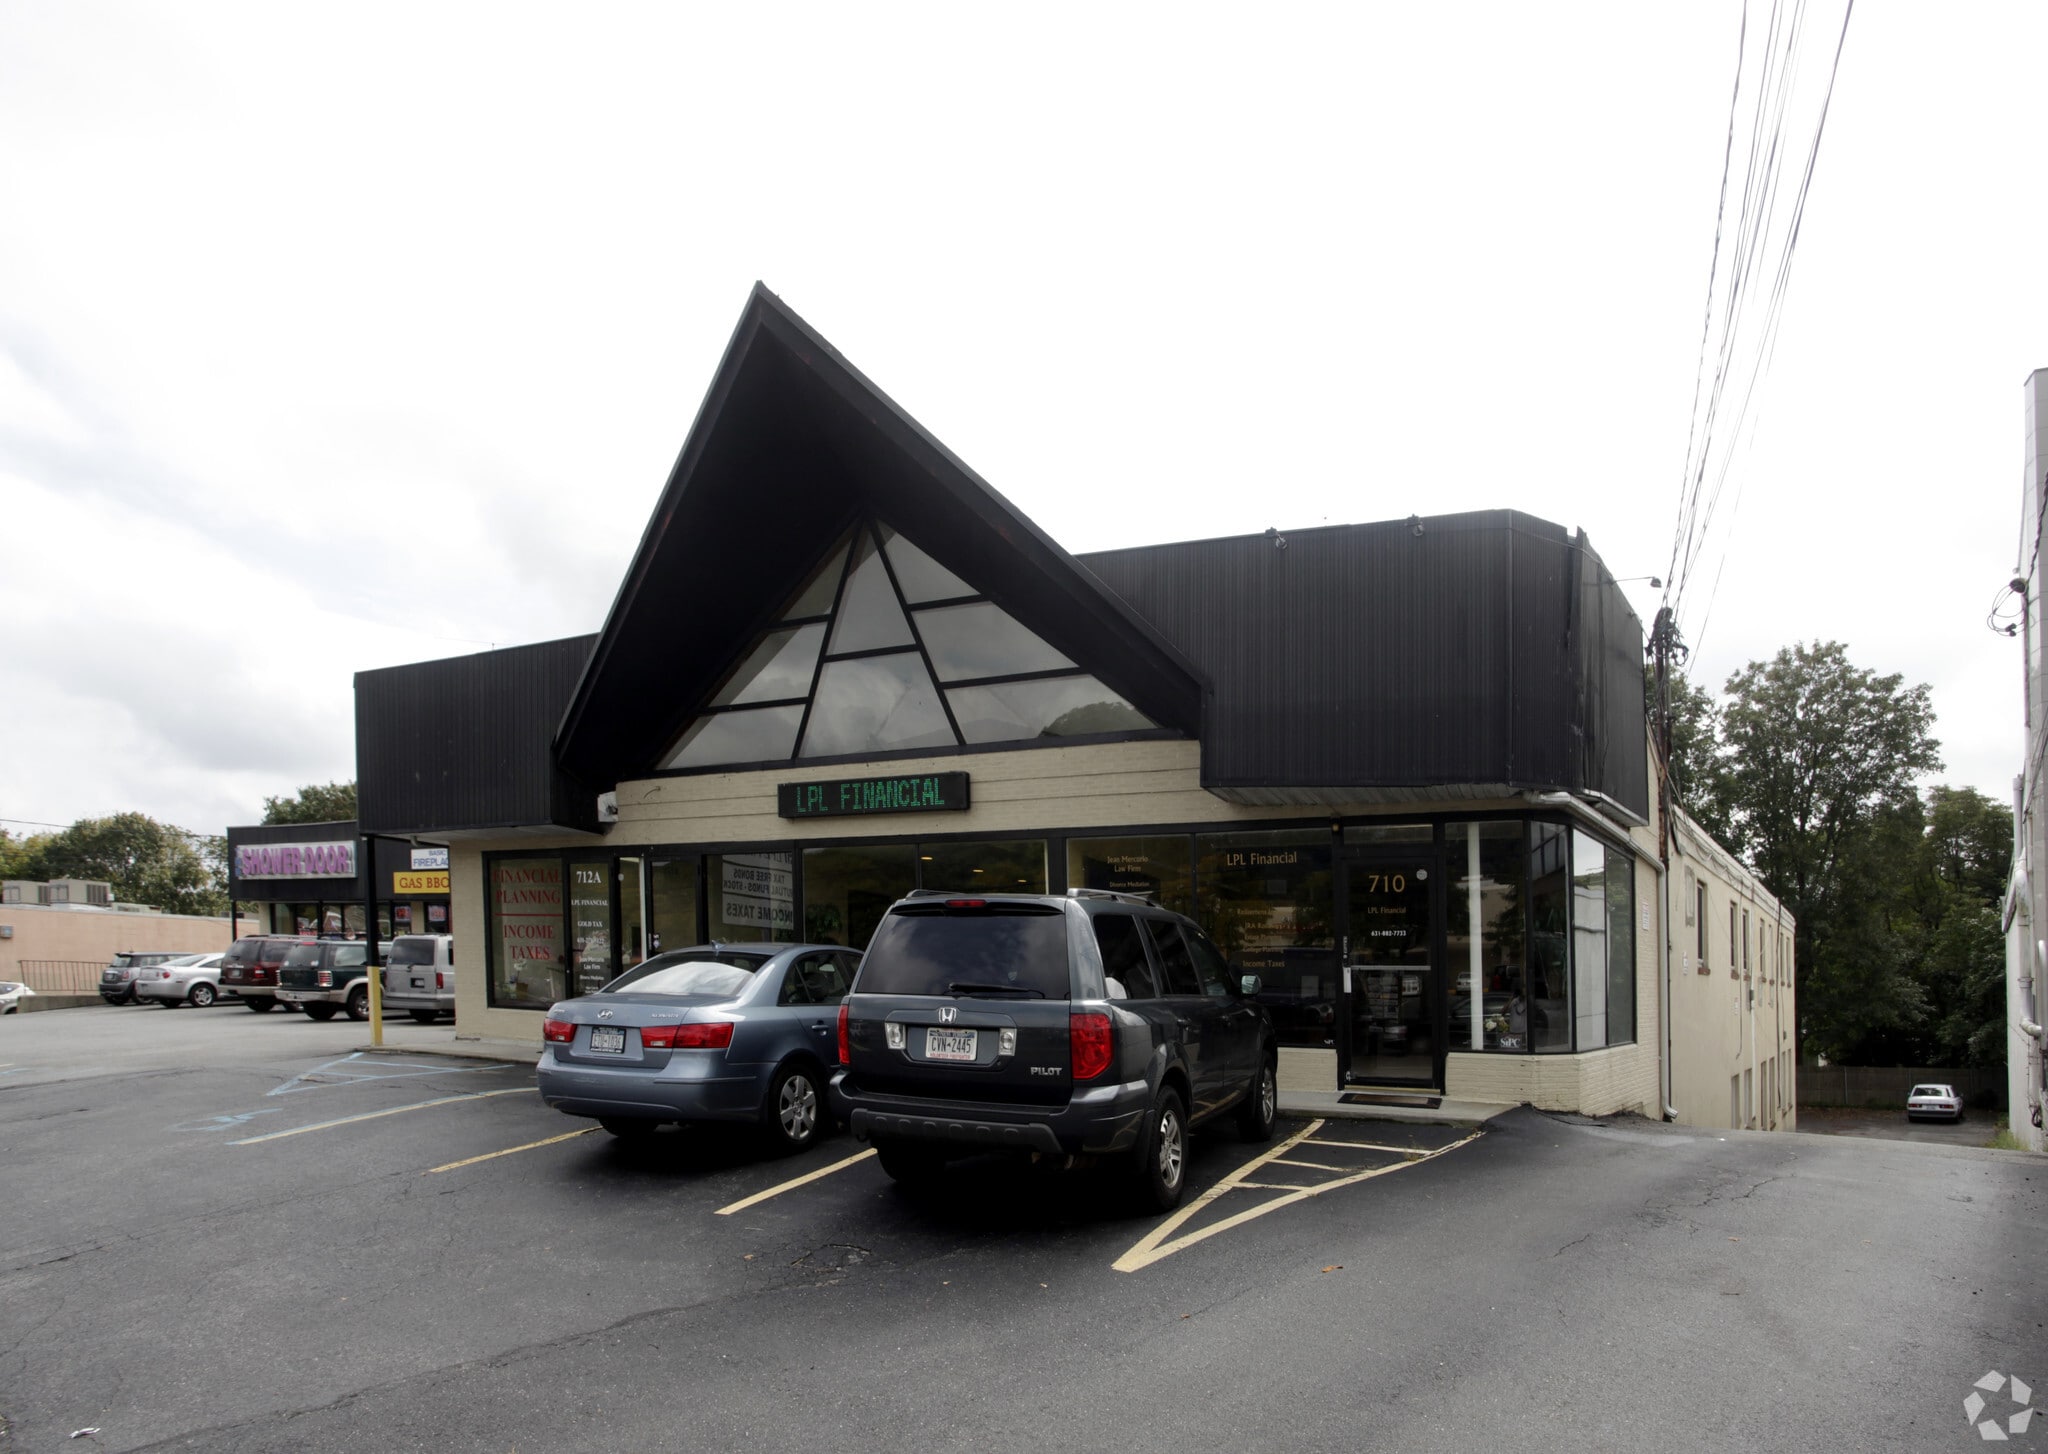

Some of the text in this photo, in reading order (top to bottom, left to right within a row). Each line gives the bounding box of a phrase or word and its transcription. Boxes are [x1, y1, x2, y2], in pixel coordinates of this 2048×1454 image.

[797, 777, 945, 813] LPL FINANCIAL
[241, 847, 300, 876] SHOWER
[304, 845, 349, 875] DOOR
[1107, 856, 1120, 864] Jean
[1226, 851, 1298, 866] LPL Financial
[493, 867, 562, 884] FINANCIAL
[1114, 864, 1142, 873] Law Firm
[399, 877, 422, 889] GAS
[576, 871, 602, 884] 712A
[1368, 874, 1406, 893] 710
[495, 889, 561, 905] PLANNING
[1367, 906, 1407, 914] LPL Financial
[503, 924, 555, 939] INCOME
[511, 945, 551, 960] TAXES
[1242, 959, 1287, 968] Income Taxes
[1030, 1066, 1063, 1076] PILOT
